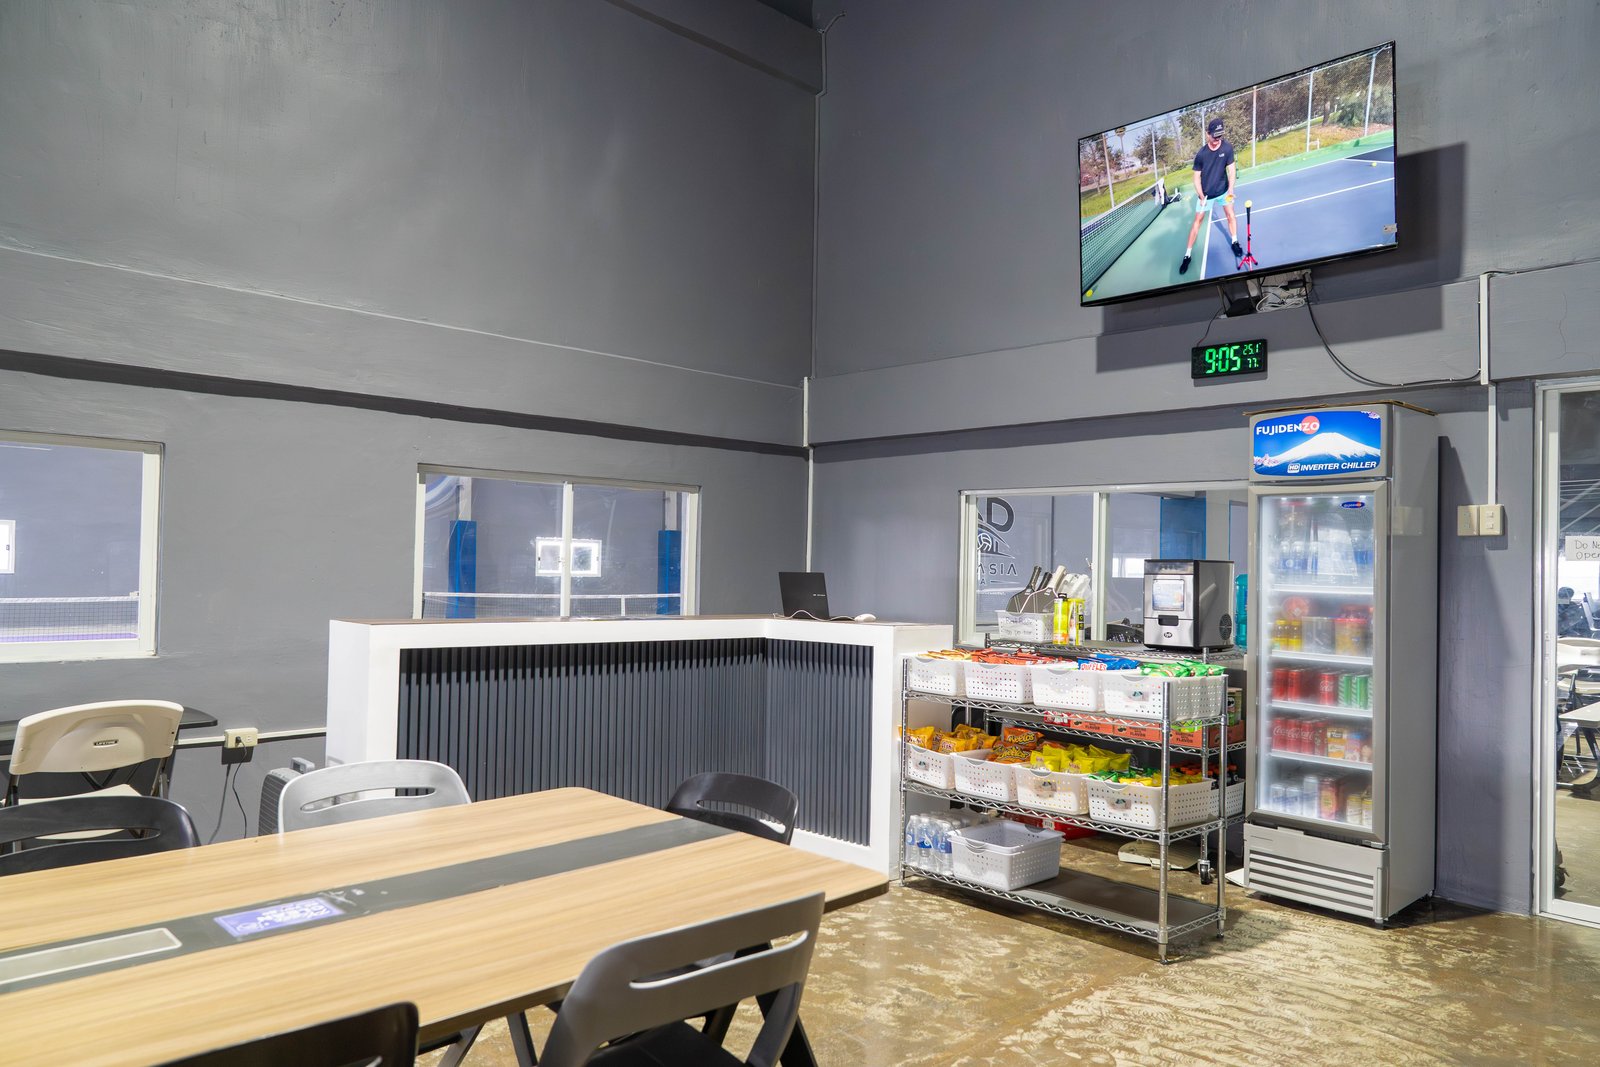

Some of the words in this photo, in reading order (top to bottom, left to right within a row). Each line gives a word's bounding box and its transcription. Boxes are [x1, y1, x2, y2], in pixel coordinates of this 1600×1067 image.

[1205, 345, 1241, 373] 9:05
[1256, 421, 1320, 435] FUJIDENZO
[1300, 463, 1339, 471] INVERTER
[1341, 461, 1377, 469] CHILLER
[978, 497, 1014, 532] D
[1575, 540, 1588, 550] Do
